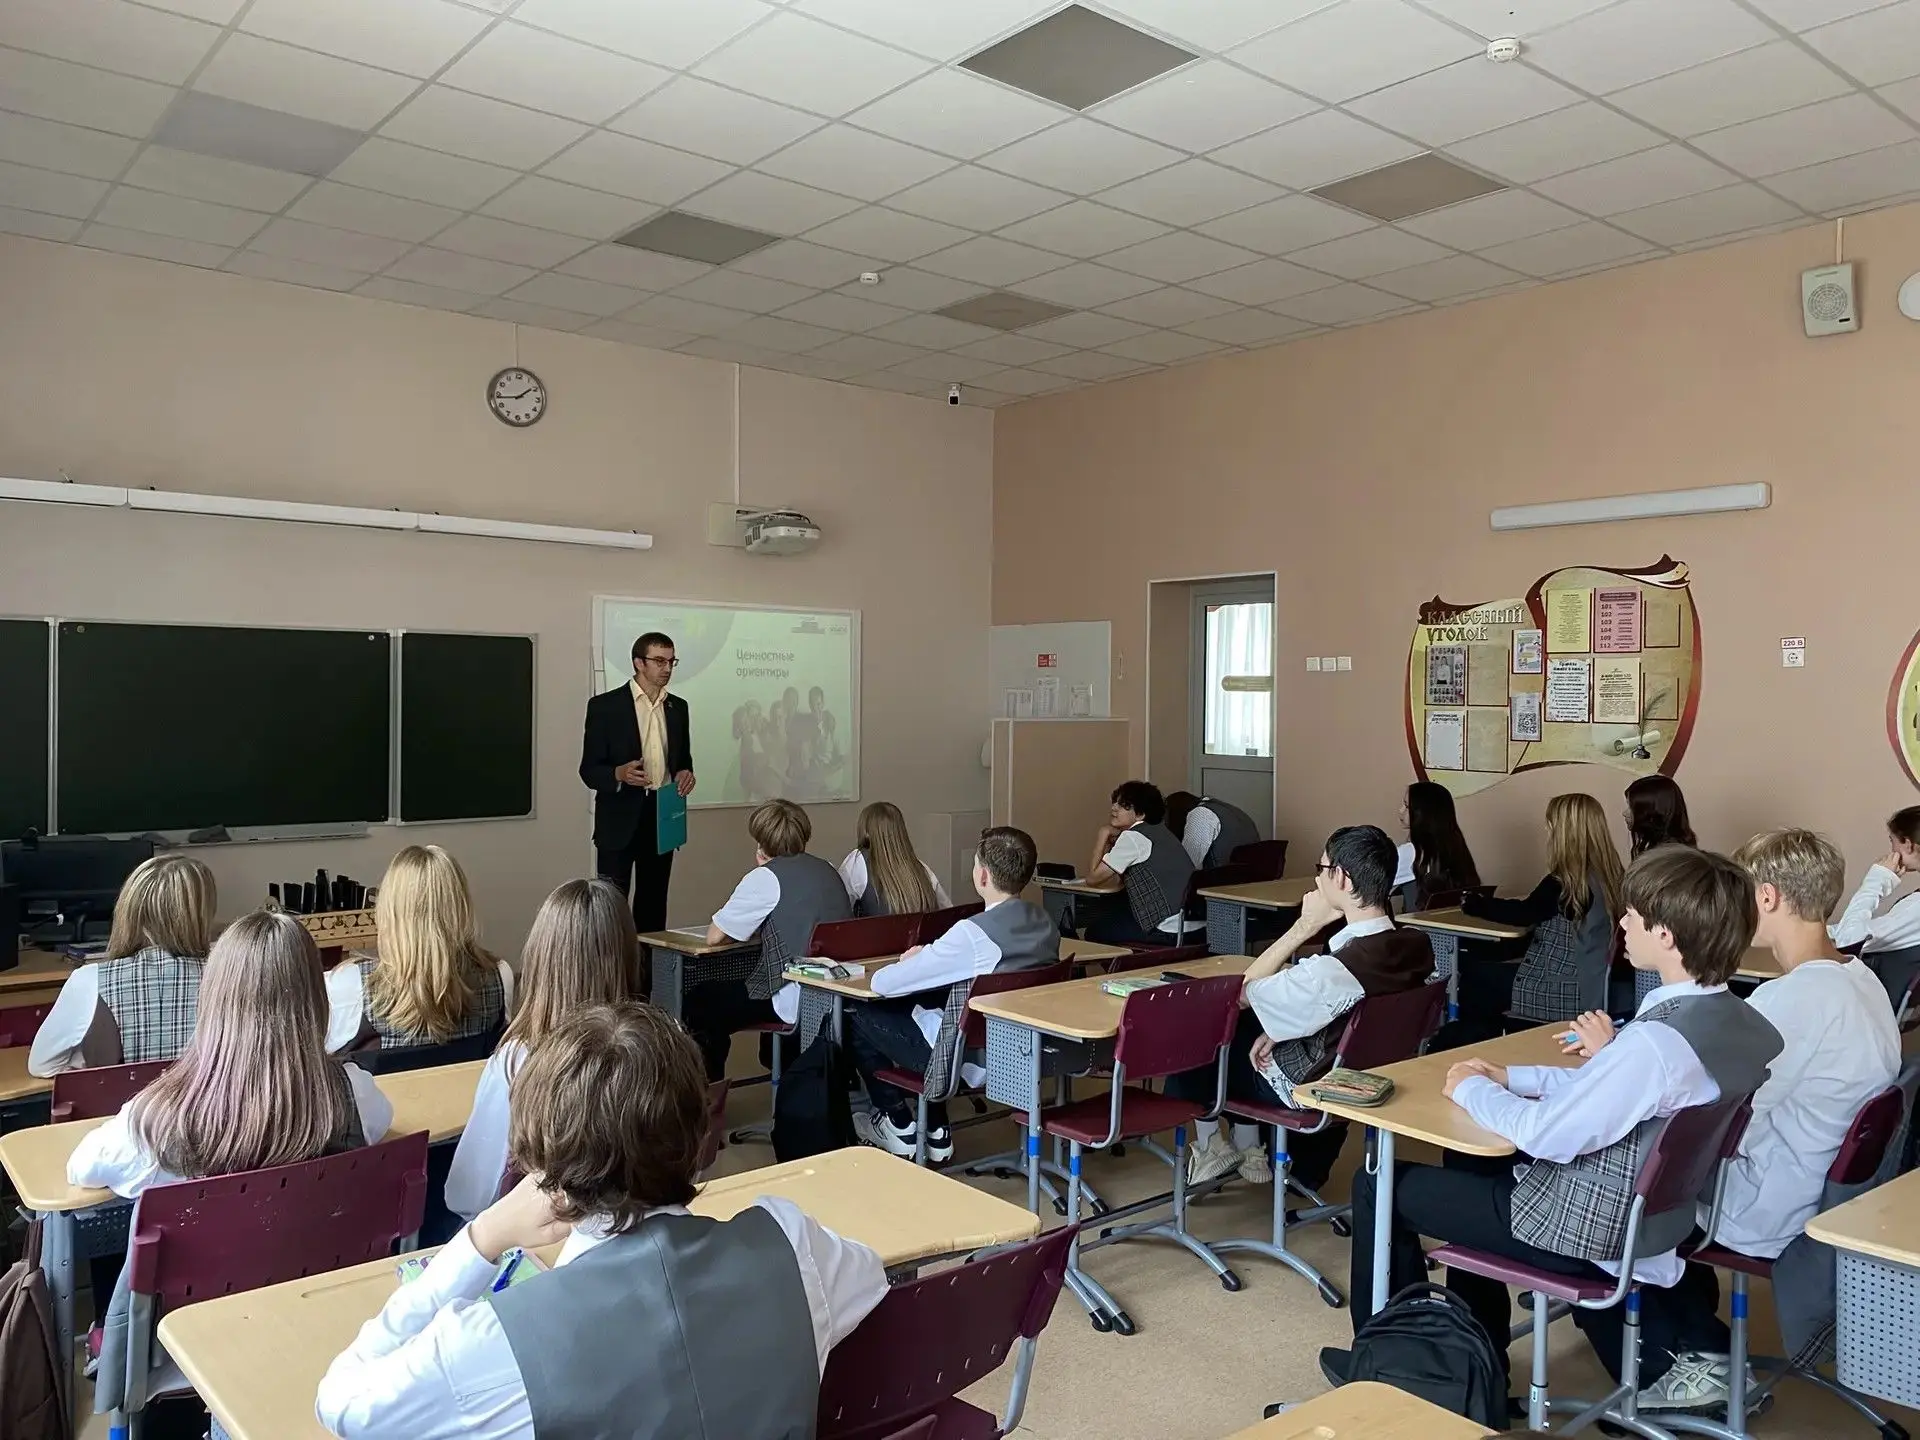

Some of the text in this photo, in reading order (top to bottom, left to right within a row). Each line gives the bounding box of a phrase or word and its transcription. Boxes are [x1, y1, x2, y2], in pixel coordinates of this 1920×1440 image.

[1427, 606, 1524, 625] КЛАССНЫЙ
[1426, 626, 1489, 645] УГОЛОК
[736, 647, 795, 664] Ценностные
[736, 667, 790, 680] ориентиры
